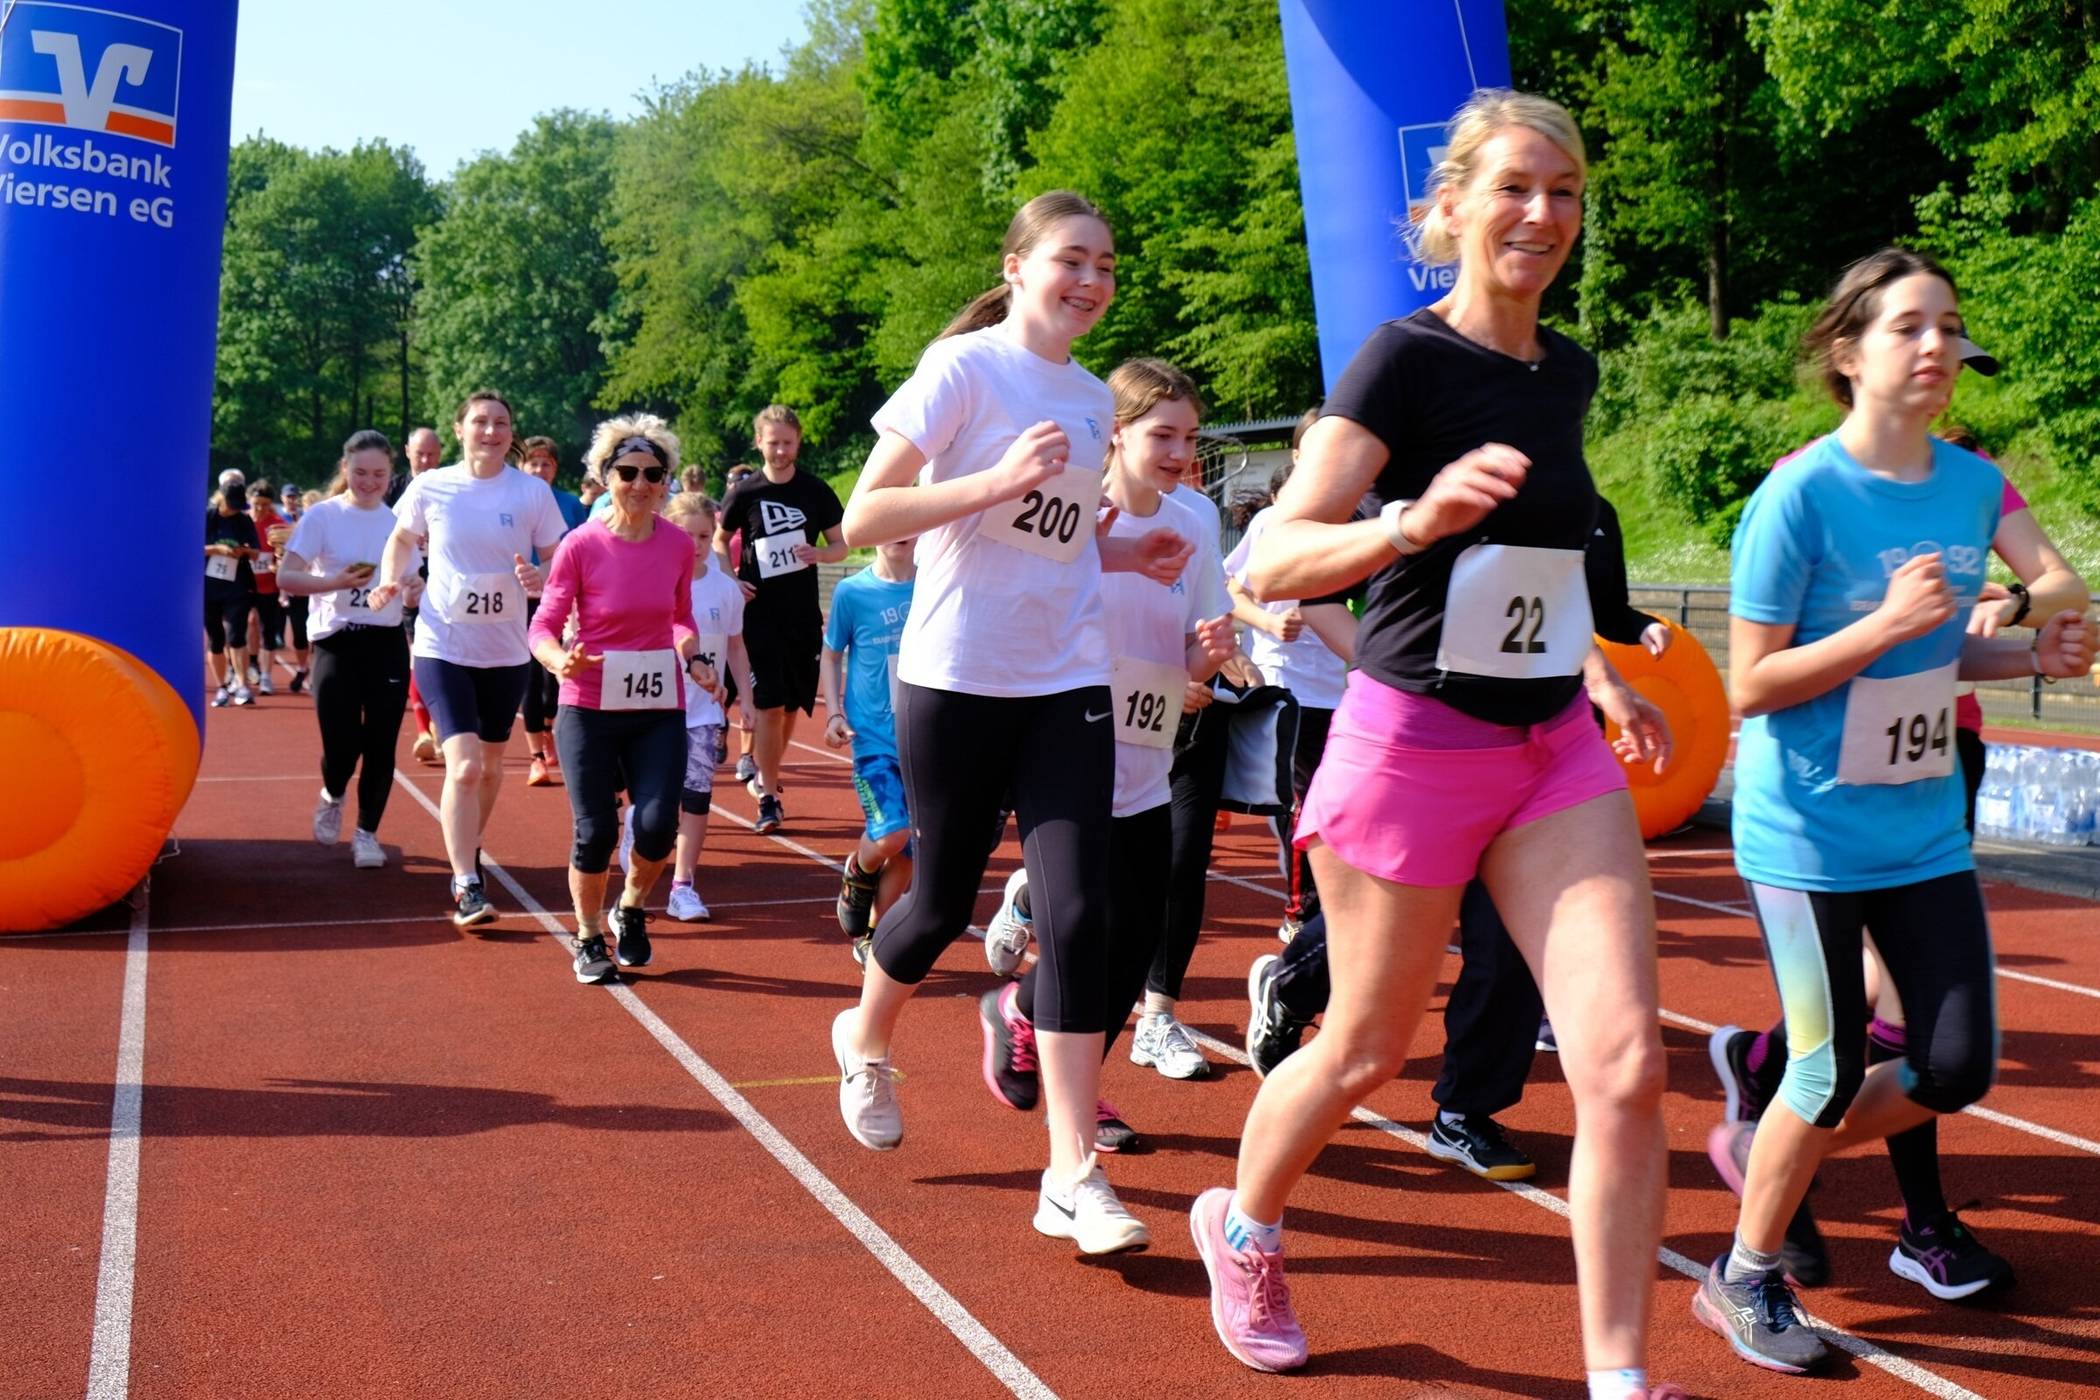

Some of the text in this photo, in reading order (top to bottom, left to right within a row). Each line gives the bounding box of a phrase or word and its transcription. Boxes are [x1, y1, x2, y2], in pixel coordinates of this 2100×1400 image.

[0, 172, 174, 229] iersen eG
[1012, 489, 1081, 544] 200
[769, 548, 797, 569] 211
[466, 592, 504, 615] 218
[879, 607, 899, 625] 19
[1500, 595, 1548, 654] 22
[623, 672, 663, 699] 145
[1124, 690, 1167, 733] 192
[1885, 707, 1949, 766] 194
